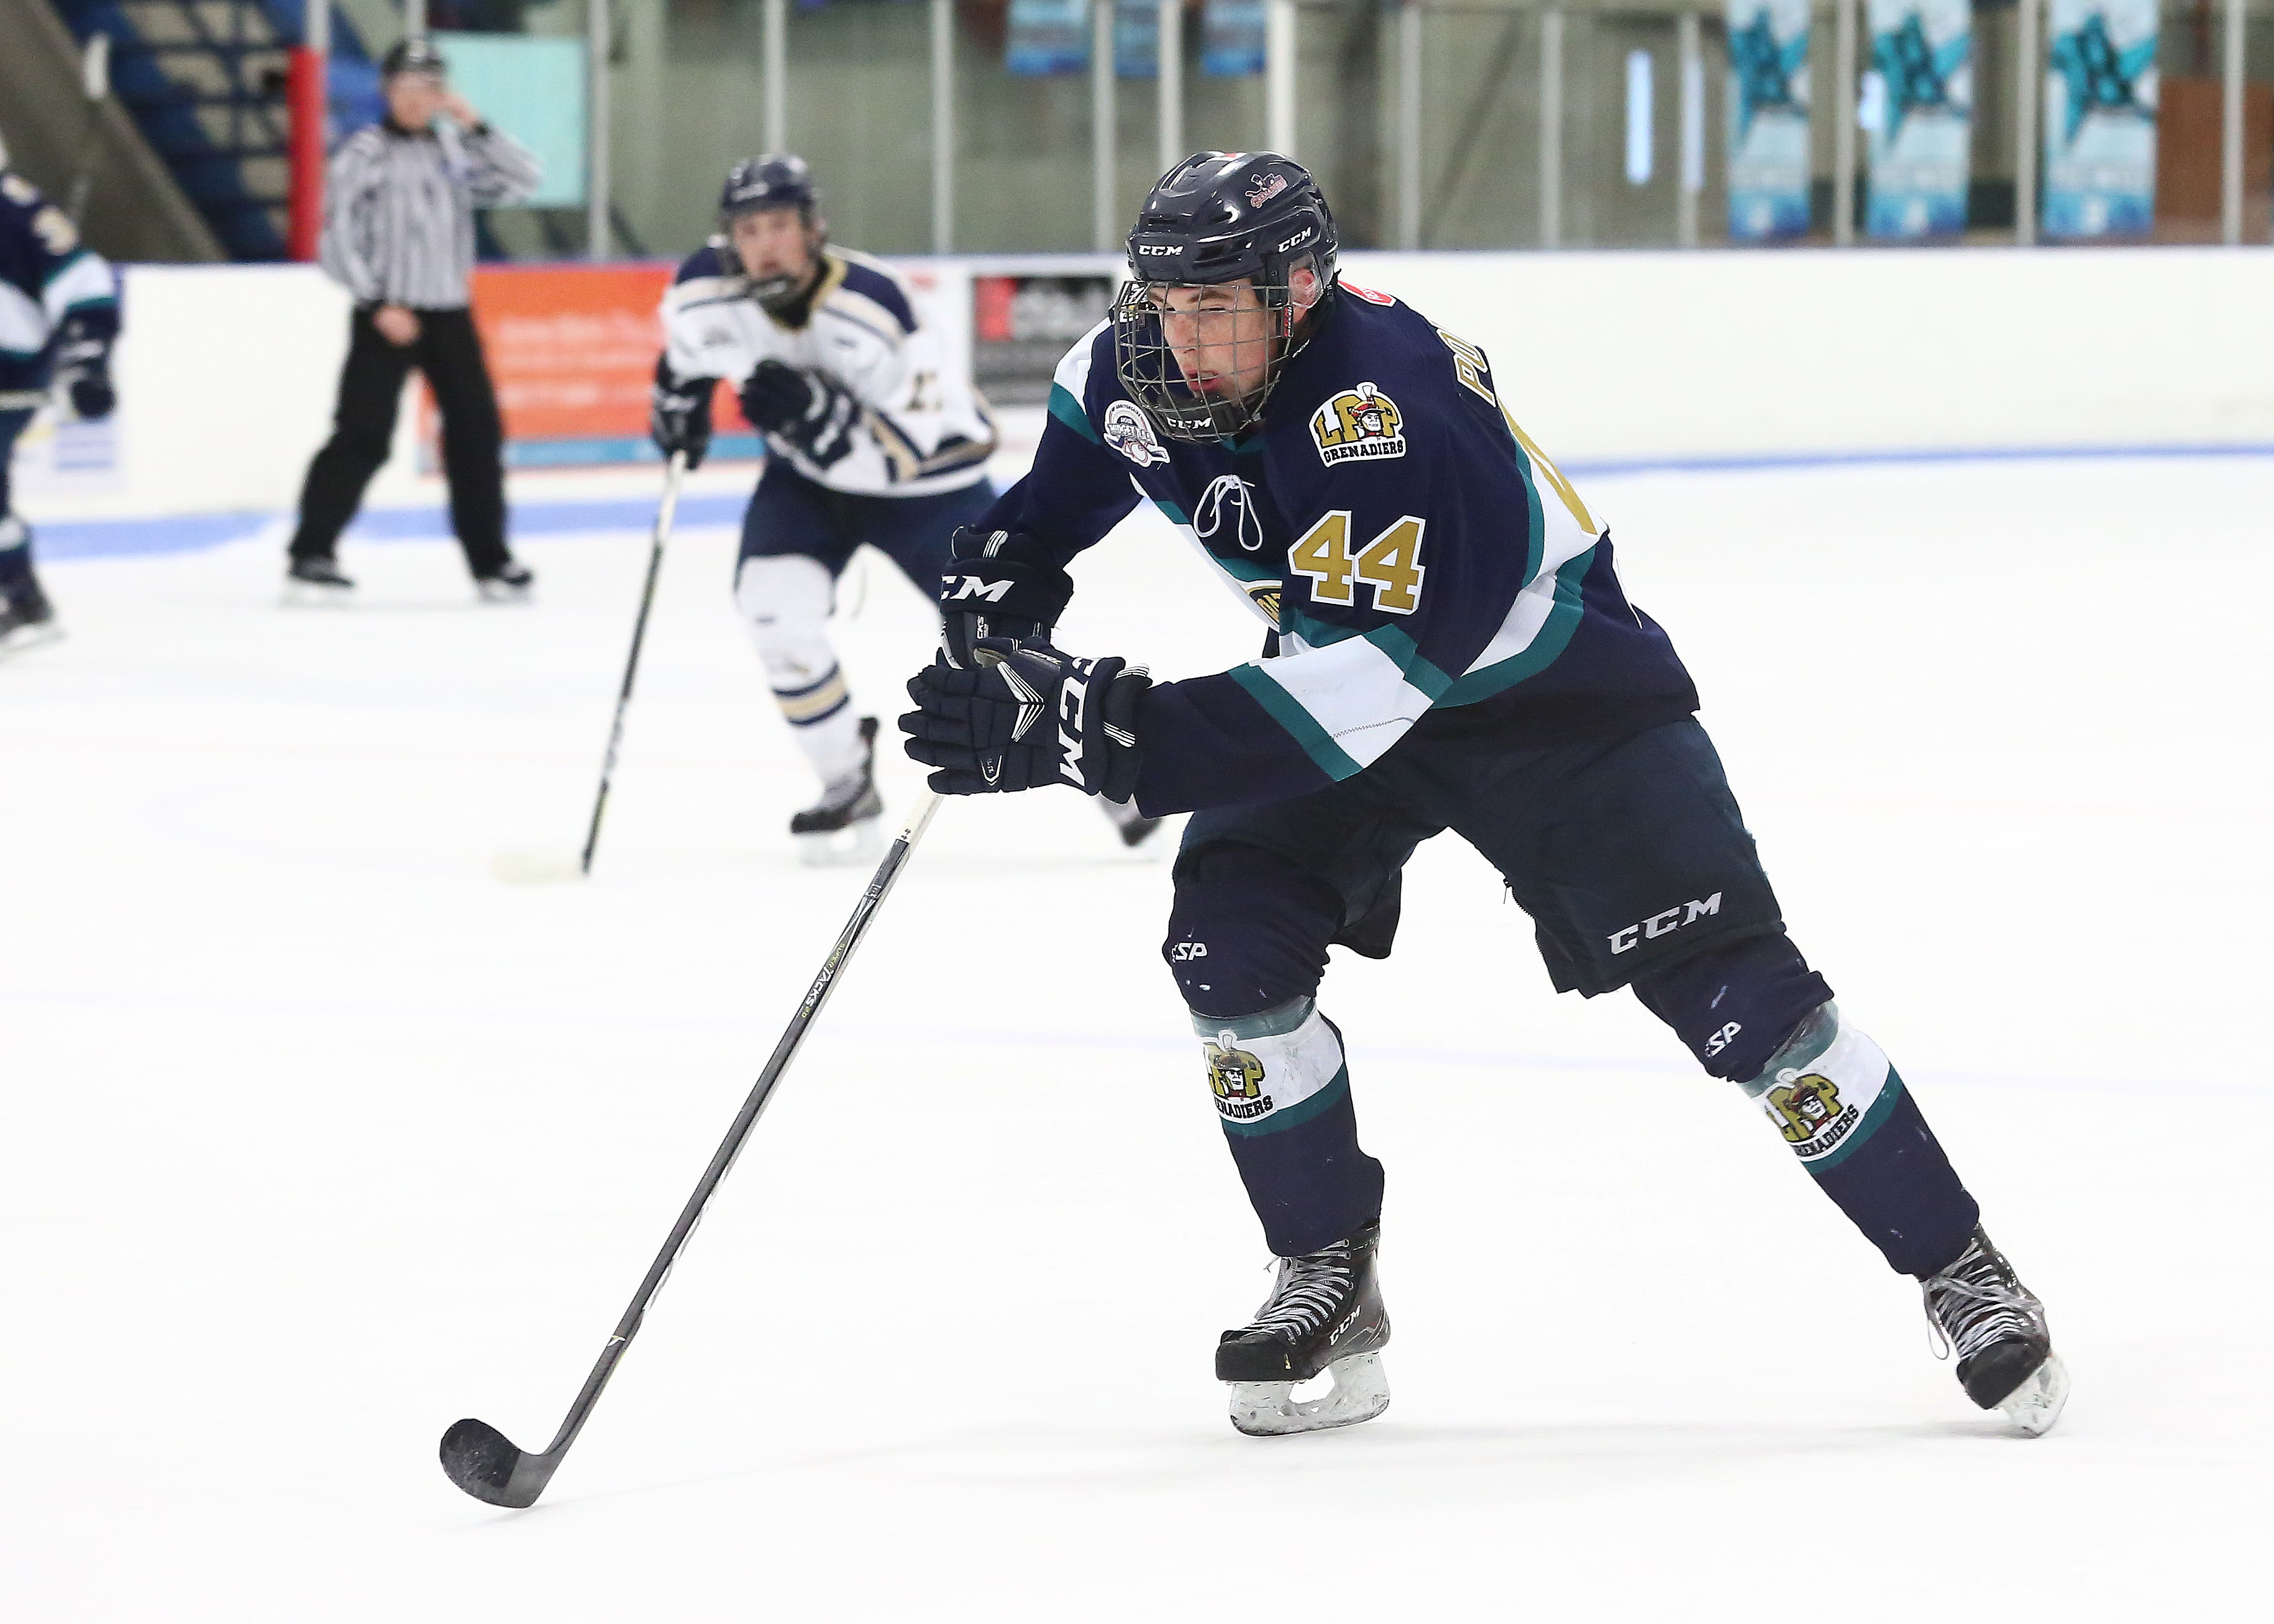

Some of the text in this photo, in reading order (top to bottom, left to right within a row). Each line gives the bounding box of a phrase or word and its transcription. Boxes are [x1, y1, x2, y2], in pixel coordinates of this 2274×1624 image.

[1138, 244, 1184, 257] CCM
[1277, 226, 1312, 253] CCM
[1166, 416, 1213, 430] CCM
[1323, 439, 1404, 463] GRENADIERS
[1287, 509, 1426, 616] 44
[940, 575, 1015, 603] CM
[1607, 891, 1722, 956] CCM
[805, 965, 834, 1008] TACKS
[1329, 1304, 1361, 1346] CCM
